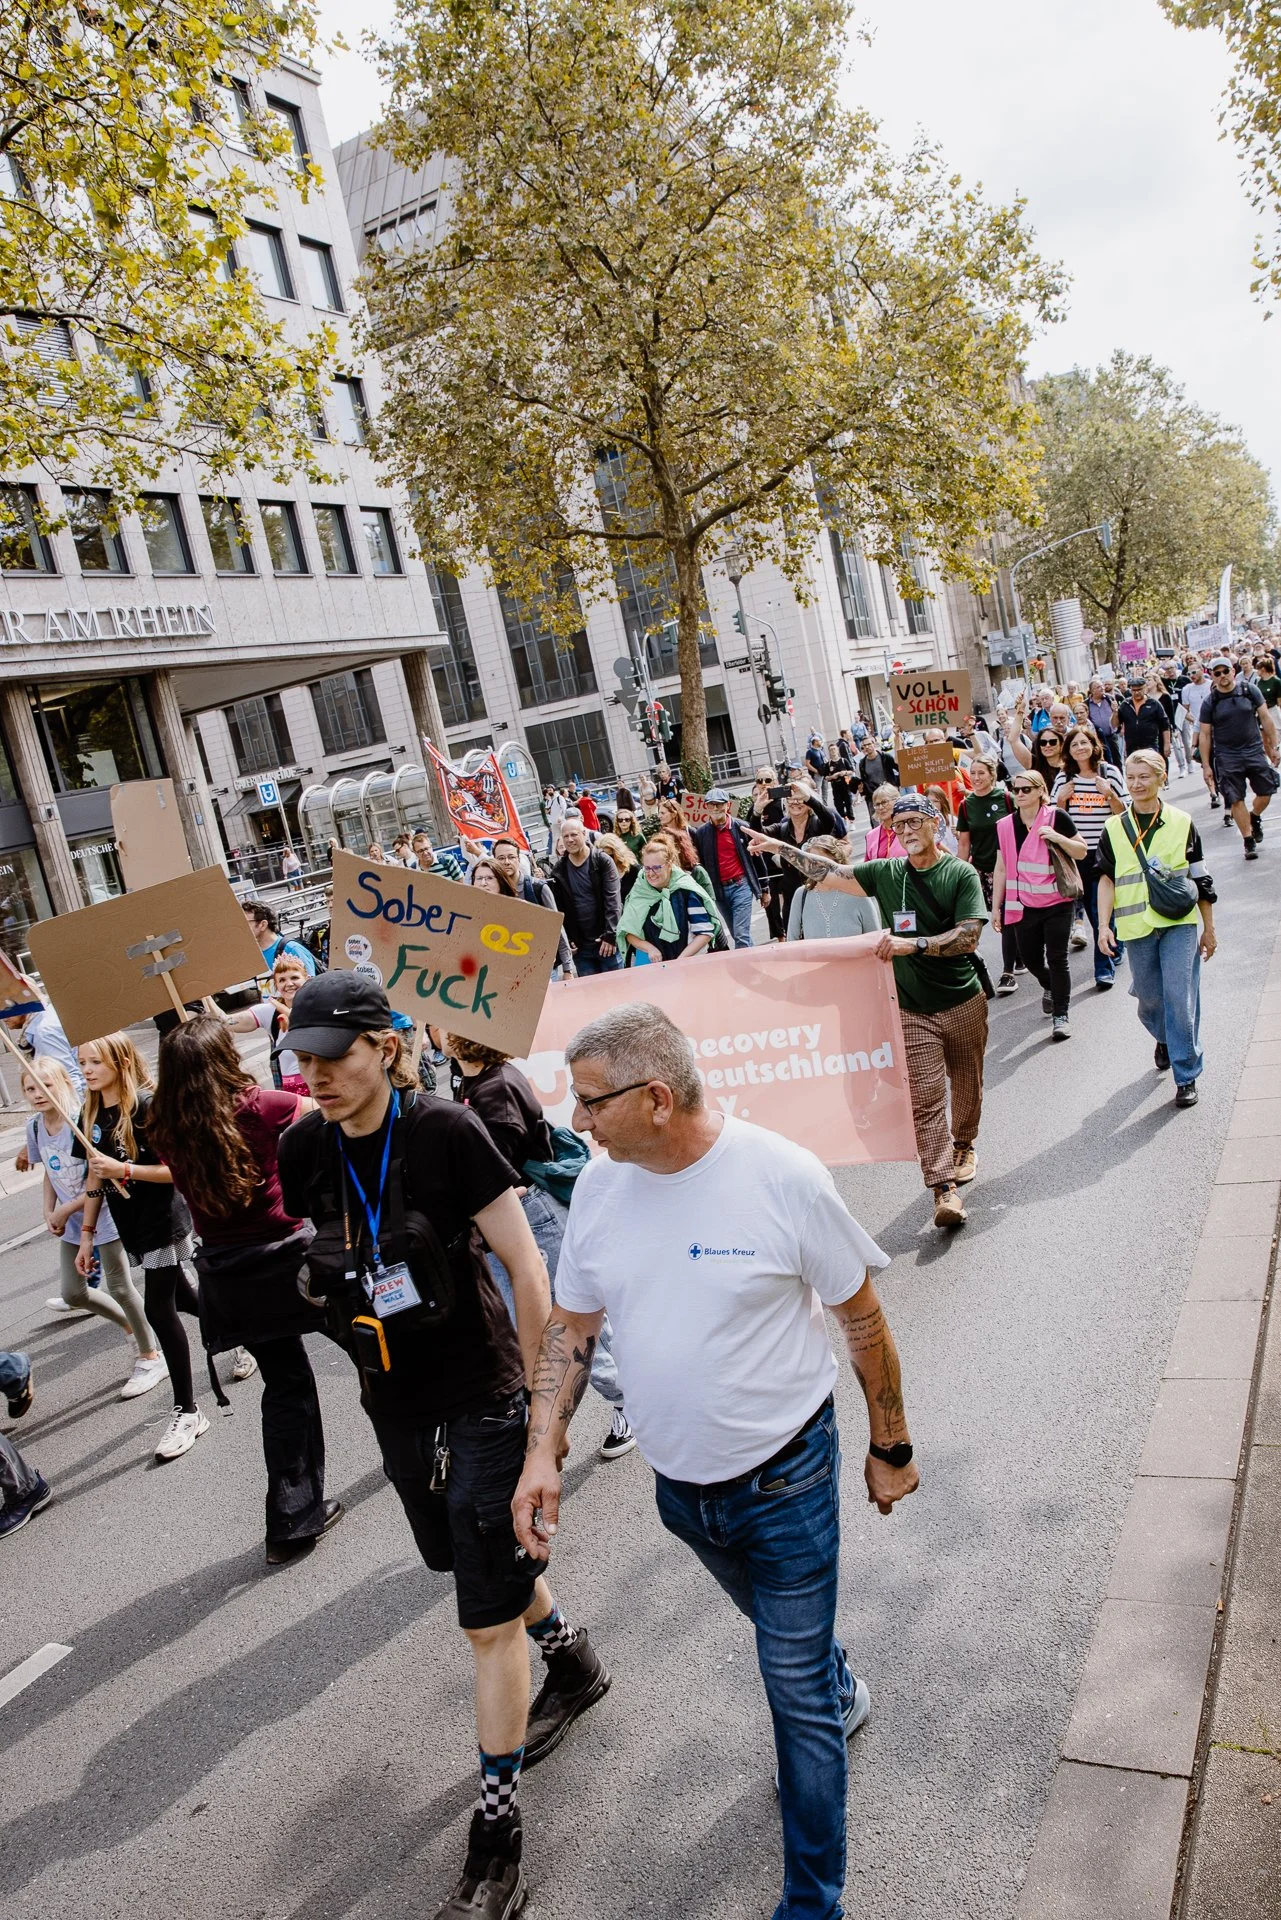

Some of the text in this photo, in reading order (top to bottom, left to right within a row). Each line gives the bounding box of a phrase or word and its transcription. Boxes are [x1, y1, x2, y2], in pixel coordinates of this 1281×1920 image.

[44, 607, 105, 641] AM
[108, 604, 217, 638] RHEIN
[896, 680, 954, 700] VOLL
[908, 694, 959, 714] SCHÖN
[915, 711, 950, 726] HIER
[70, 843, 114, 860] DEUTSCHE
[346, 871, 473, 935] Sober
[386, 943, 498, 1020] Fuck
[704, 1247, 755, 1256] Blaues Kreuz
[374, 1277, 404, 1295] CREW
[383, 1293, 404, 1304] WALK
